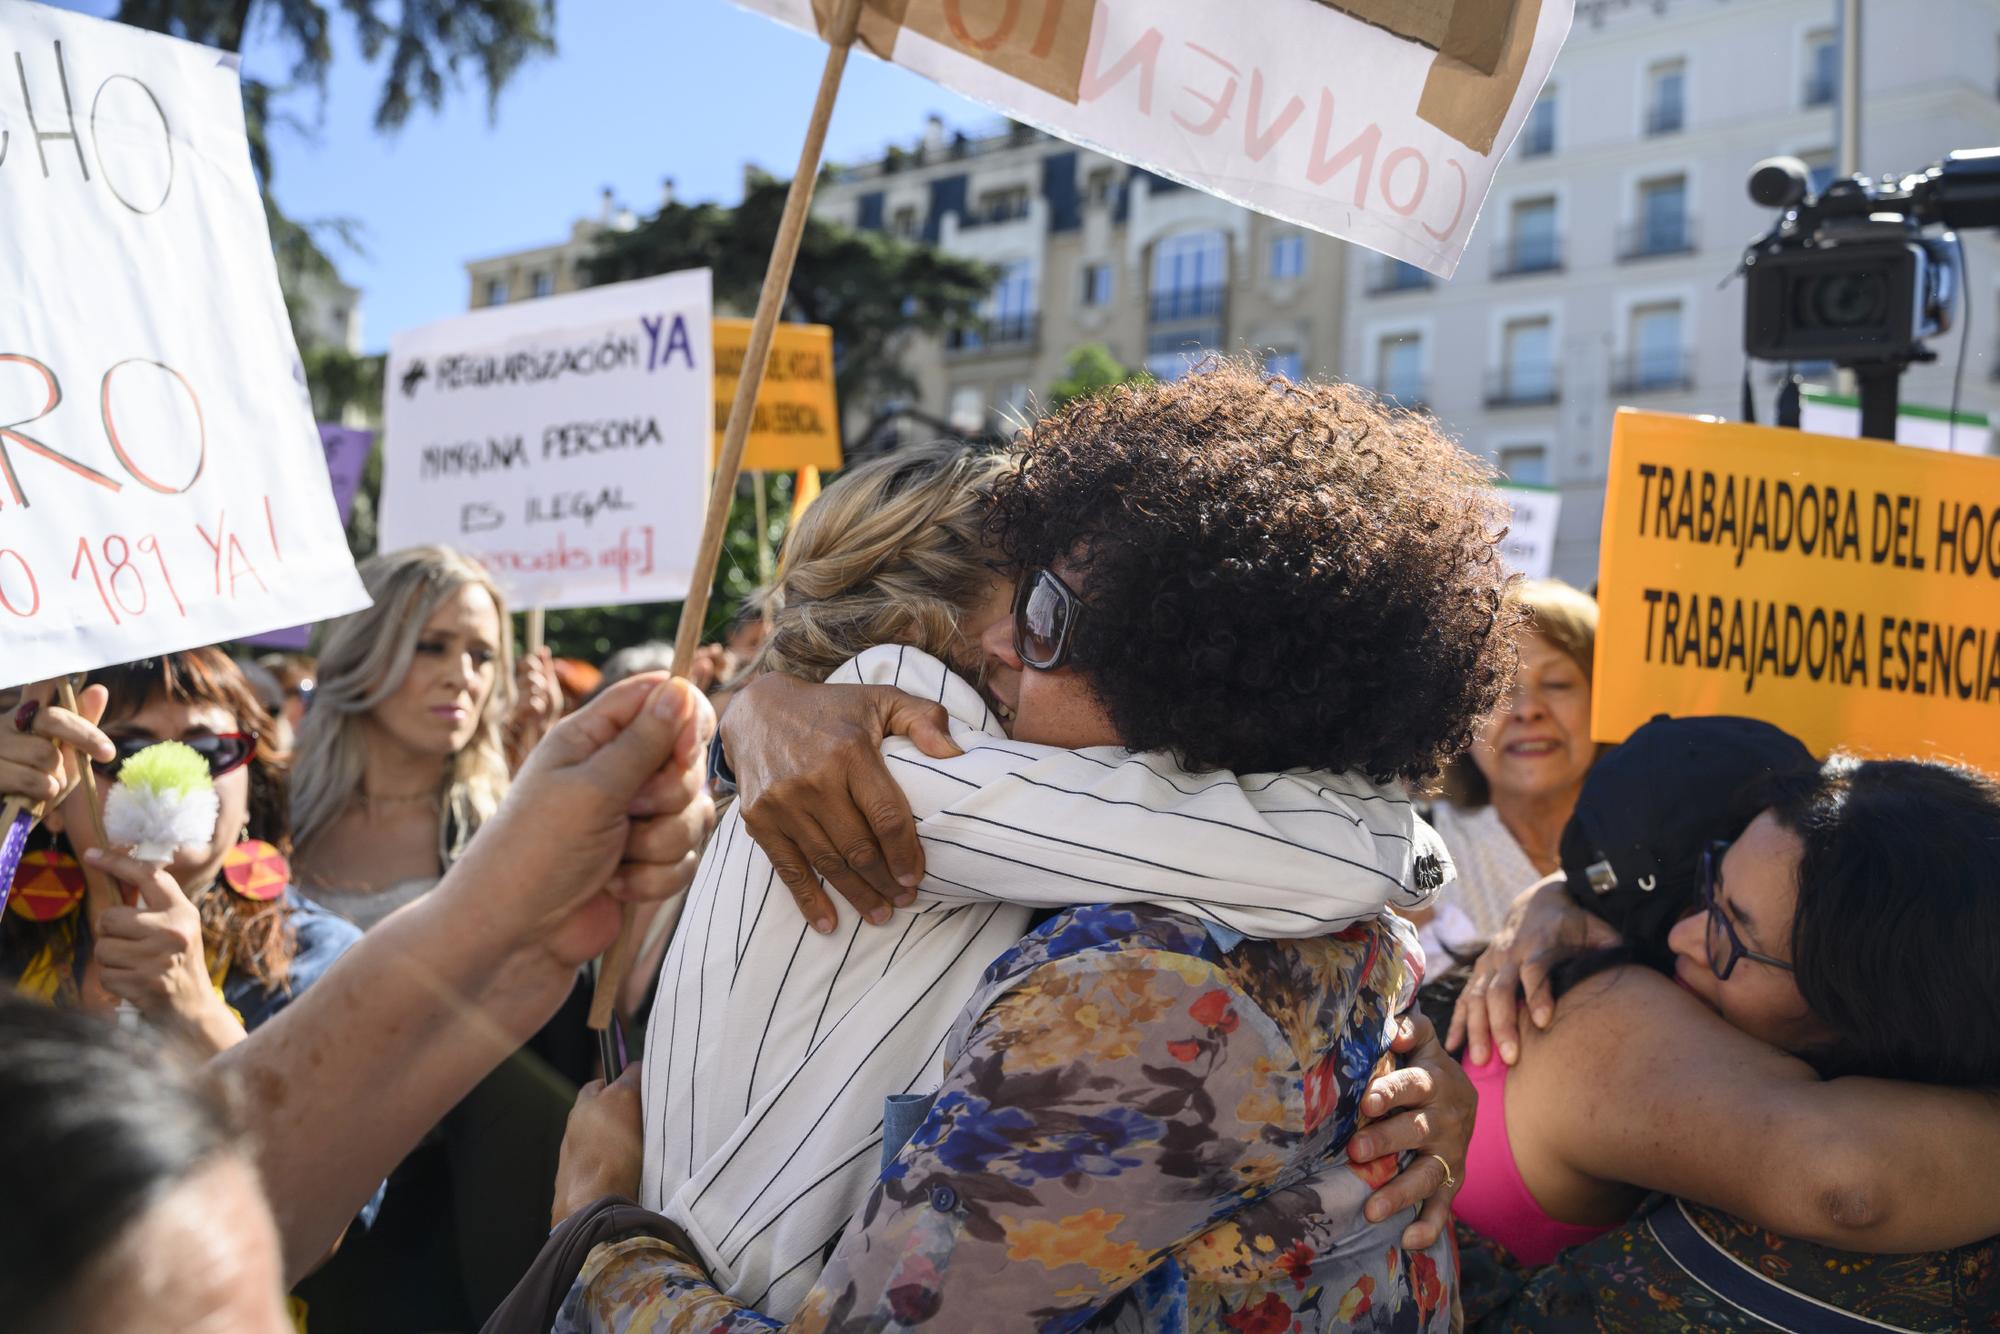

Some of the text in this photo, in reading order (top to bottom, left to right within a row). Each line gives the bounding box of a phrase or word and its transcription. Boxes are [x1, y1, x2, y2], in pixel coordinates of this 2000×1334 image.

[0, 39, 174, 215] HO
[642, 314, 695, 372] YA
[542, 417, 662, 461] PERSONA
[1638, 463, 1860, 569] TRABAJADORA
[1871, 492, 1925, 570] DEL
[71, 534, 186, 625] 189
[1643, 588, 2000, 704] TRABAJADORA ESENCIA
